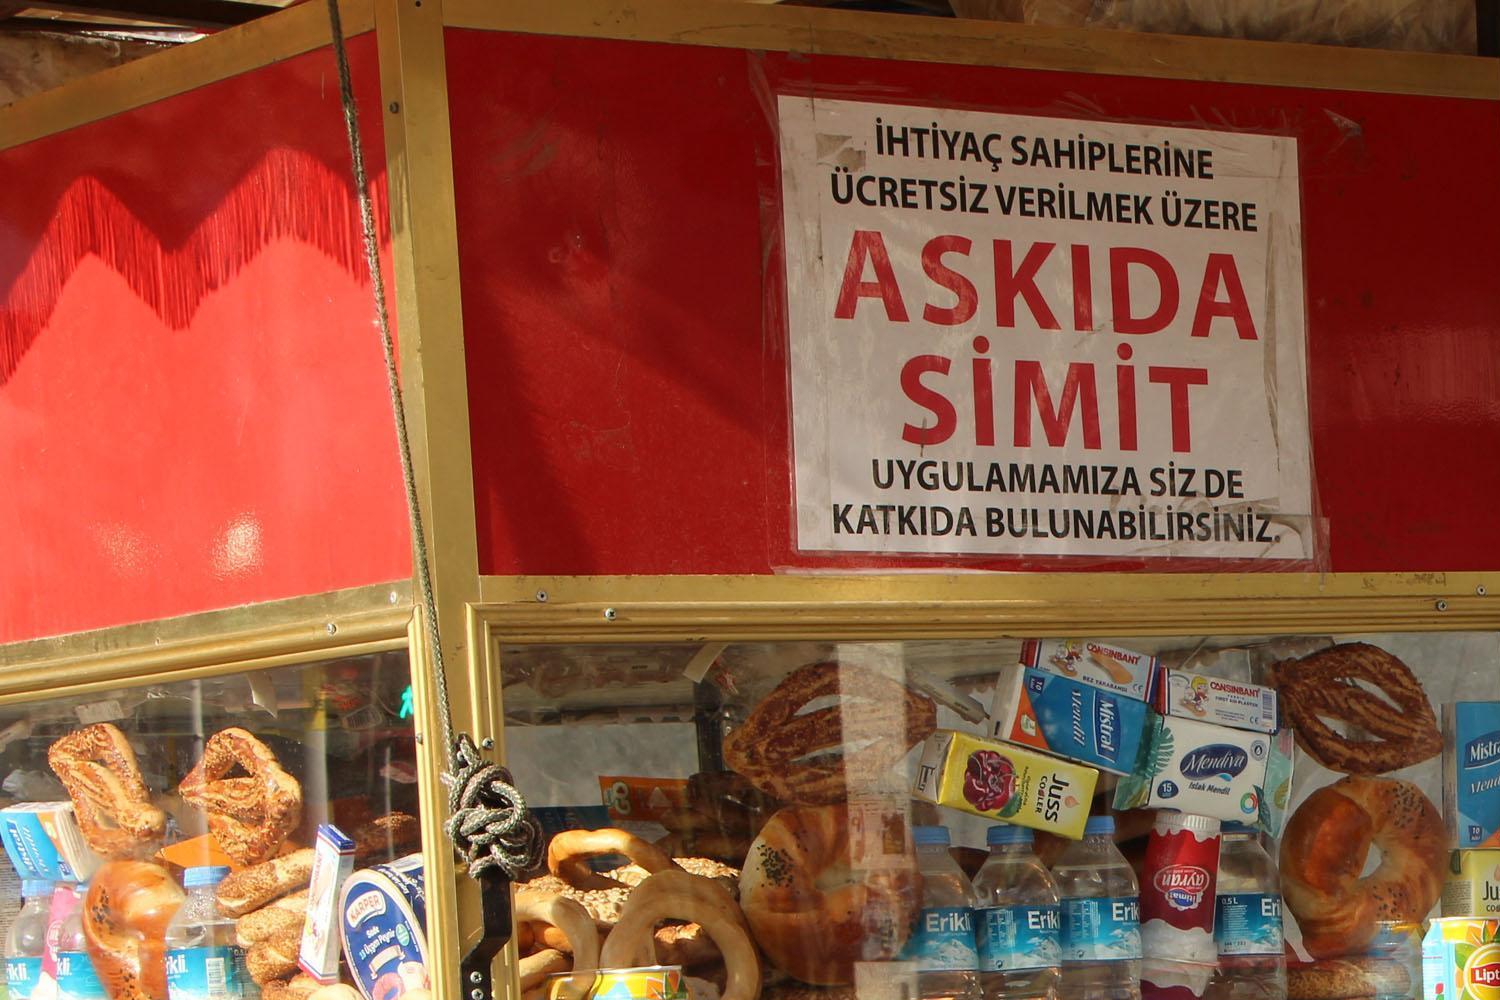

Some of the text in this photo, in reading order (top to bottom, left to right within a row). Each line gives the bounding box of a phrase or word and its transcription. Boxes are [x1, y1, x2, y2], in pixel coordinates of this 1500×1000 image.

[875, 117, 1214, 180] İHTİYAÇ SAHİPLERİNE
[830, 166, 1257, 232] ÜCRETSİZ VERİLMEK ÜZERE
[834, 230, 1258, 340] ASKIDA
[900, 336, 1208, 453] SİMİT
[871, 459, 1244, 499] UYGULAMAMIZA SİZ DE
[832, 504, 1281, 544] KATKIDA BULUNABİLİRSİNİZ.
[1099, 700, 1115, 752] Mistral
[1182, 751, 1245, 773] Mendiva
[1044, 774, 1069, 823] Juss
[1162, 783, 1172, 793] 15
[1112, 902, 1140, 921] Erik
